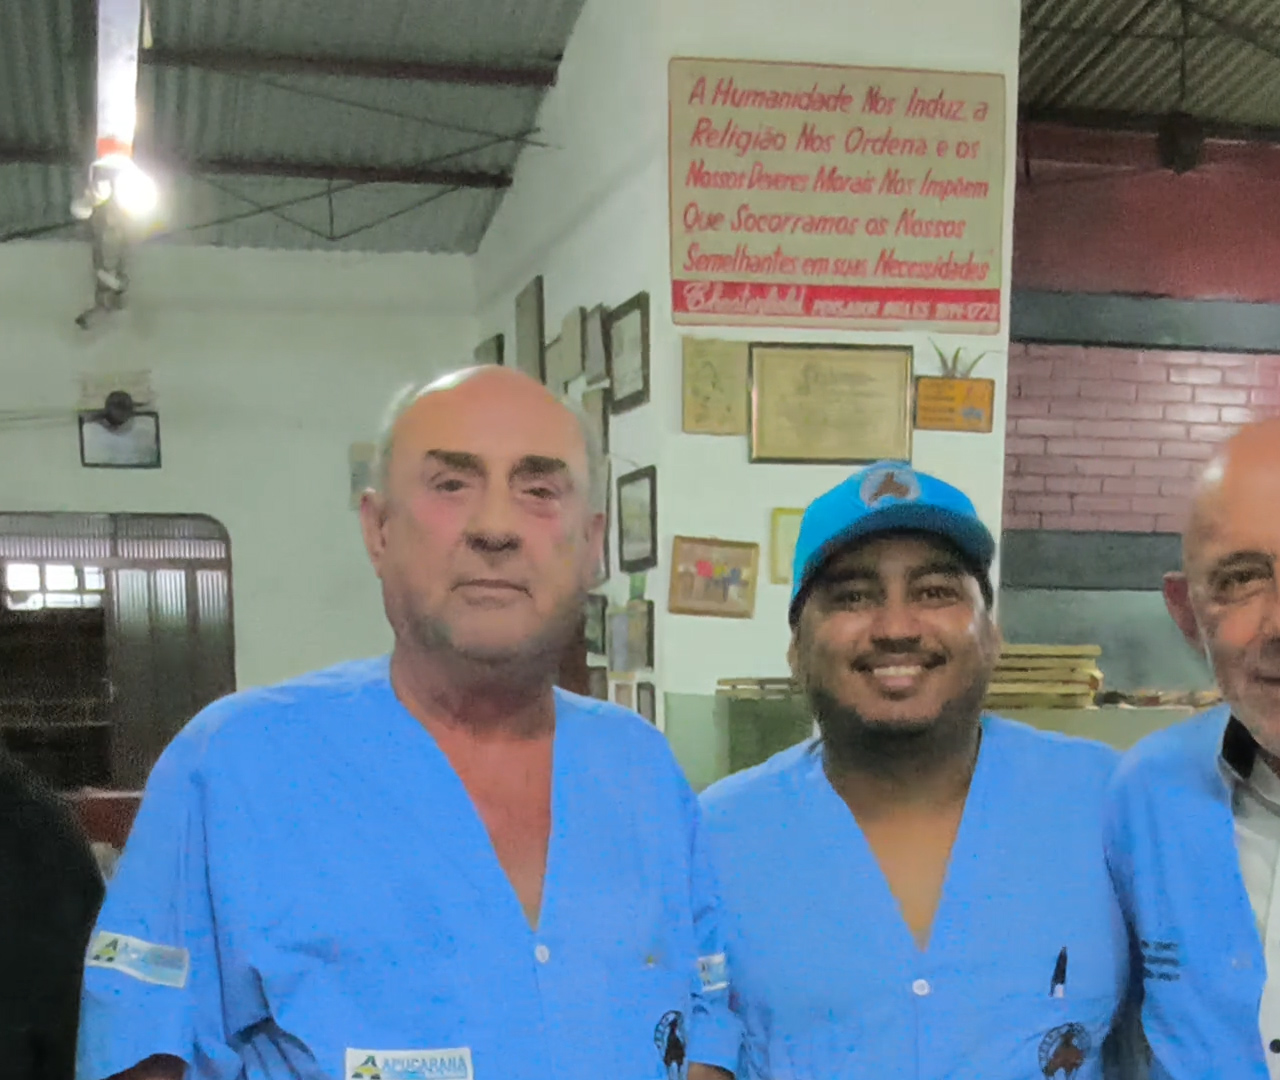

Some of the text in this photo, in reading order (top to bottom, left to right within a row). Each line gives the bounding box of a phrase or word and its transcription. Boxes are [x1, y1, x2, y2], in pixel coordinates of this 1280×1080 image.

[688, 76, 989, 122] A Humanidade Nos Induz a
[690, 117, 981, 160] Religião Nos Ordena e os
[685, 158, 745, 189] Nossos
[813, 165, 876, 195] Morais
[878, 167, 916, 196] Nos
[683, 201, 967, 239] Que Socorramos os Nossos
[683, 241, 797, 276] Semelhantes
[802, 257, 830, 276] em
[874, 247, 991, 281] Necessidades
